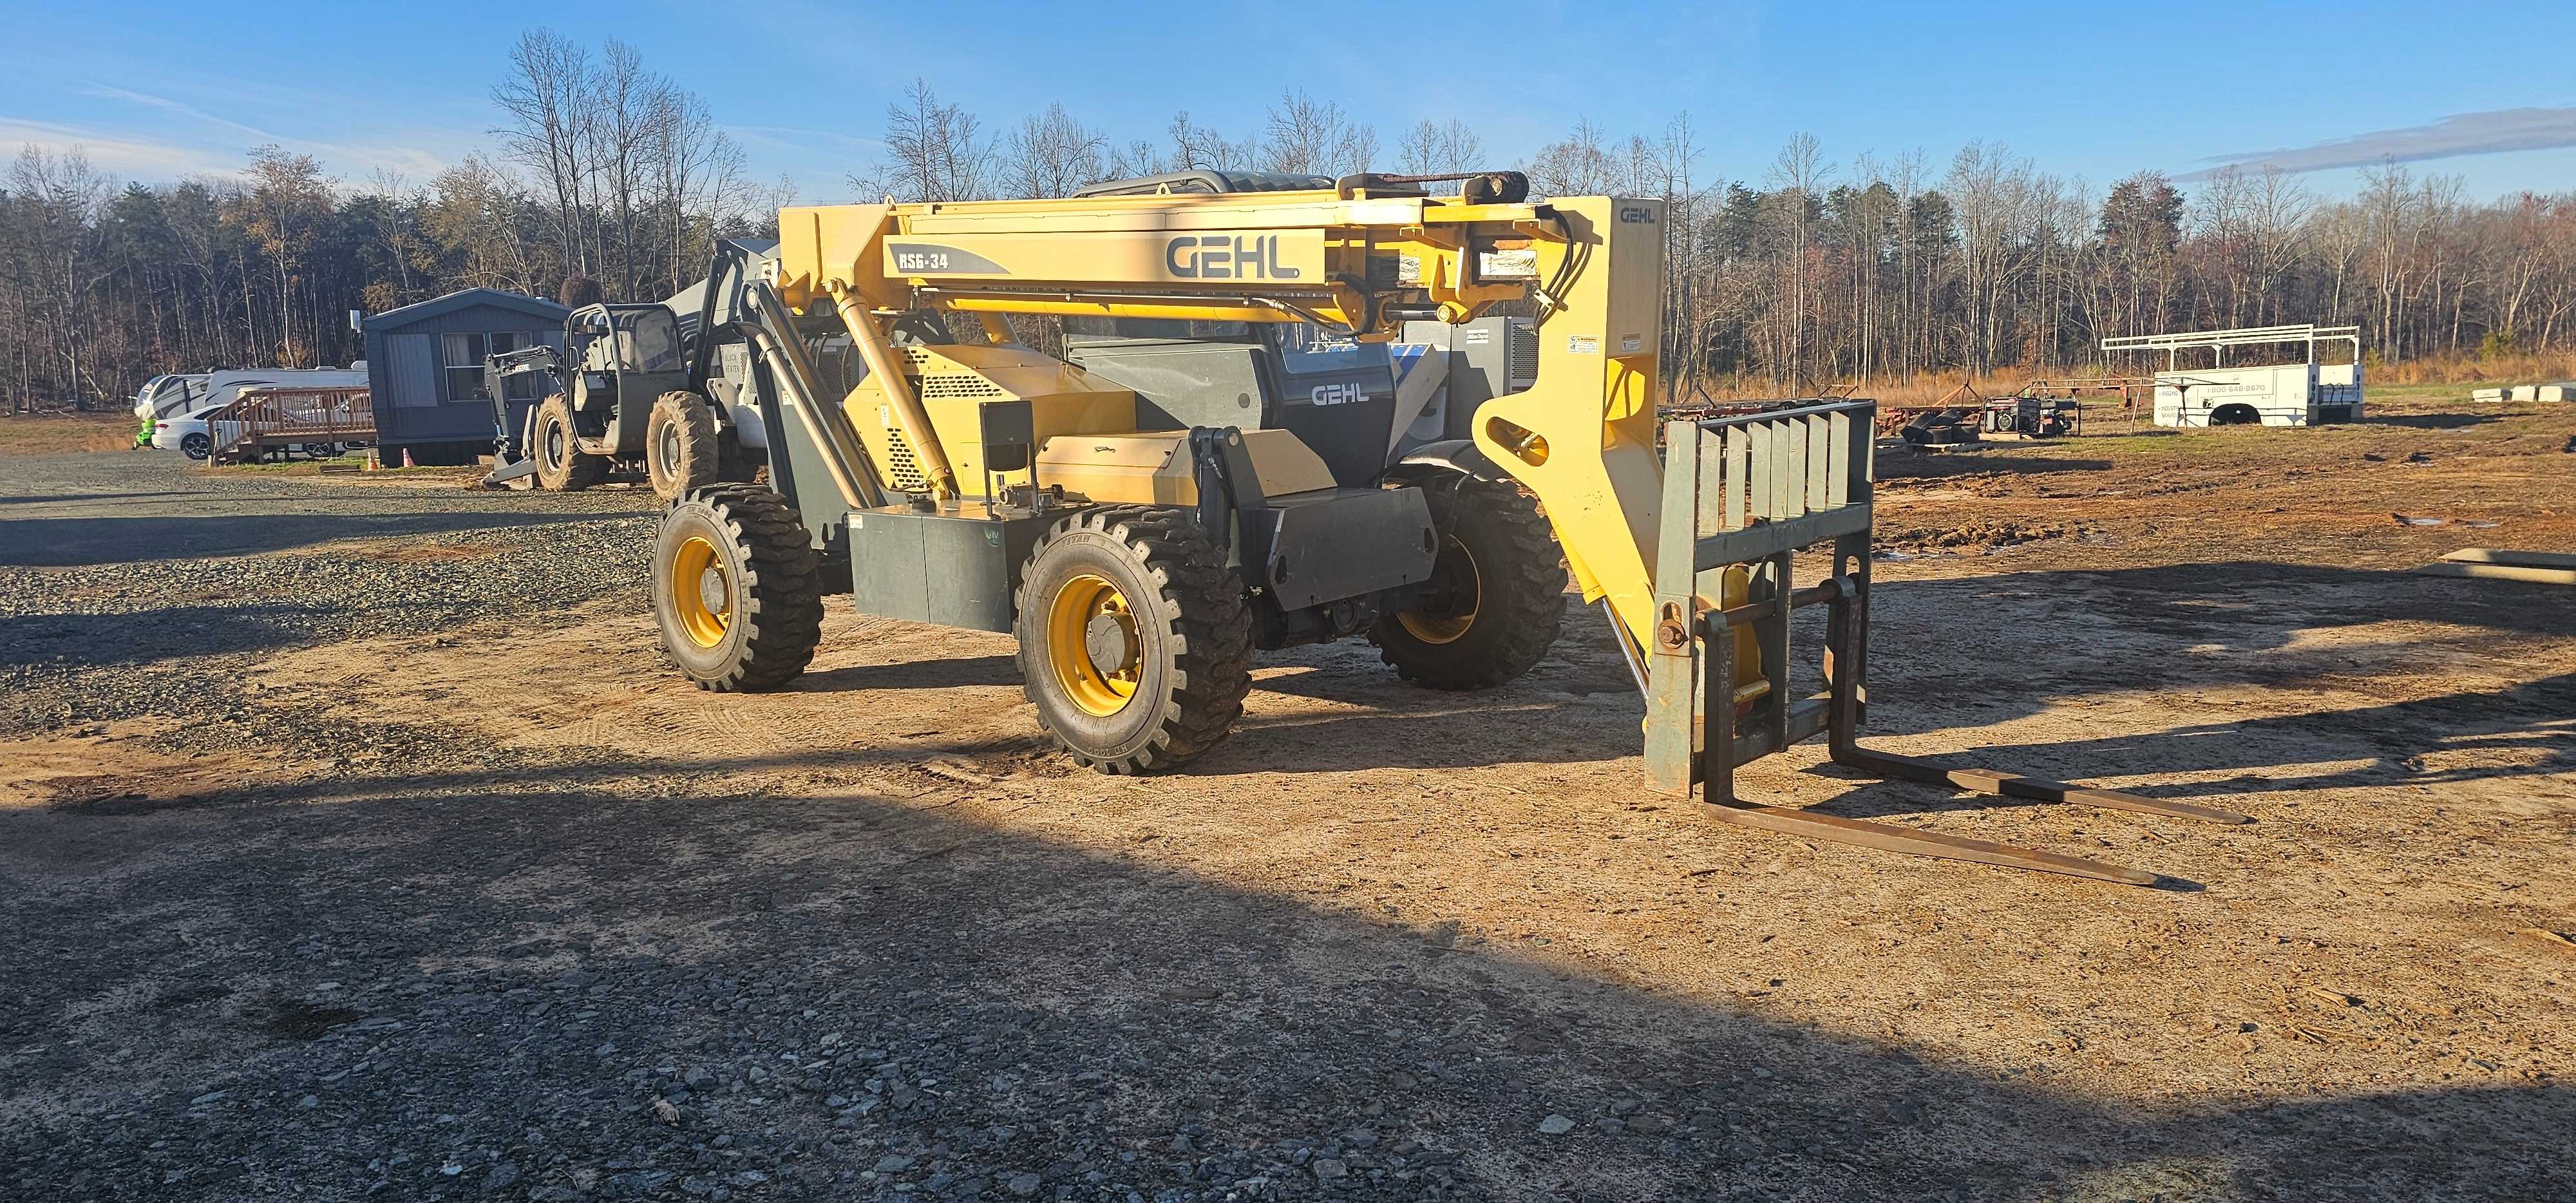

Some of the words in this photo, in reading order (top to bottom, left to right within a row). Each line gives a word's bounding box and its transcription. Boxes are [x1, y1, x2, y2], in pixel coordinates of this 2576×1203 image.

[1620, 207, 1656, 223] GEHL
[899, 253, 949, 269] RS6-34
[1166, 235, 1300, 278] GEHL
[1312, 383, 1369, 406] GEHL
[1061, 534, 1092, 547] TITAN
